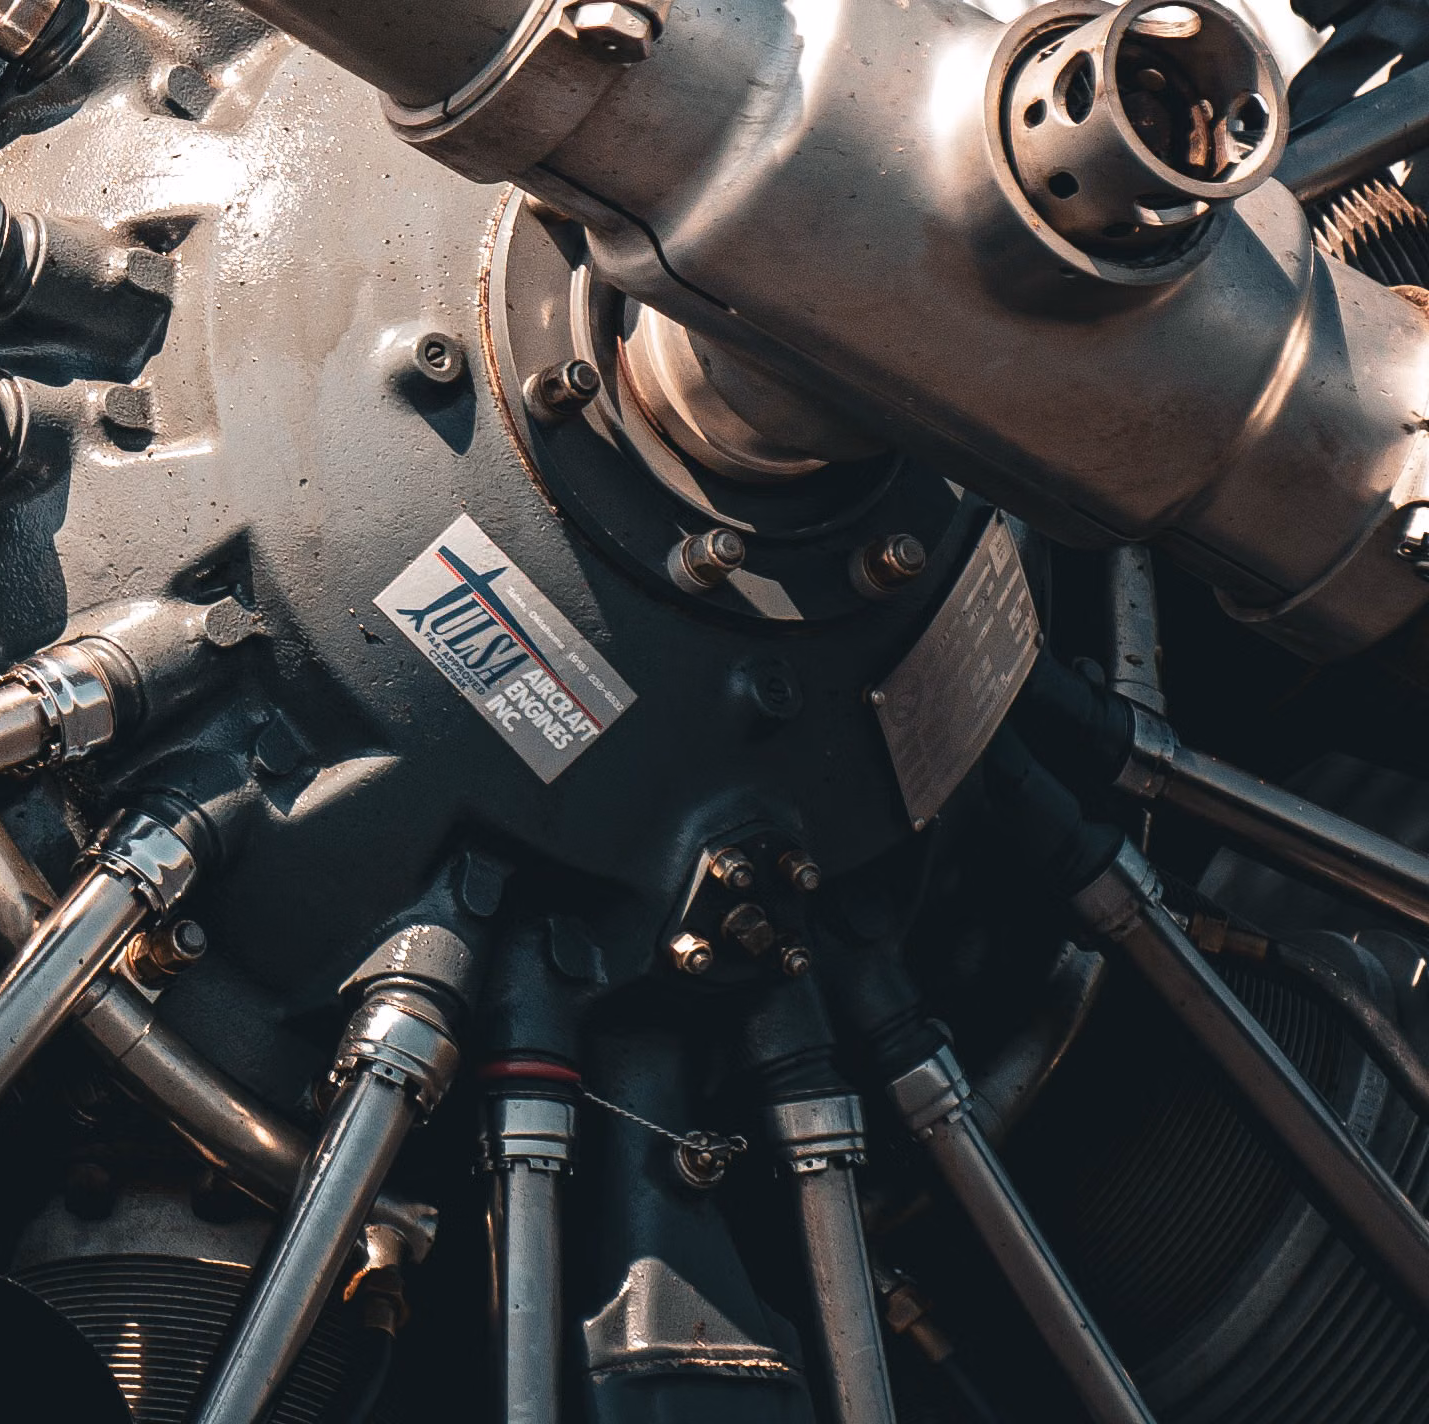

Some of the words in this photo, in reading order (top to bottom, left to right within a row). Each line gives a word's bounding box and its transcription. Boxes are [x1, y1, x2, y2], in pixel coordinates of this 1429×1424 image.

[423, 631, 441, 650] FAA
[441, 651, 486, 695] APPROVED
[504, 680, 574, 750] ENGINES
[522, 668, 600, 742] AIRCRAFT
